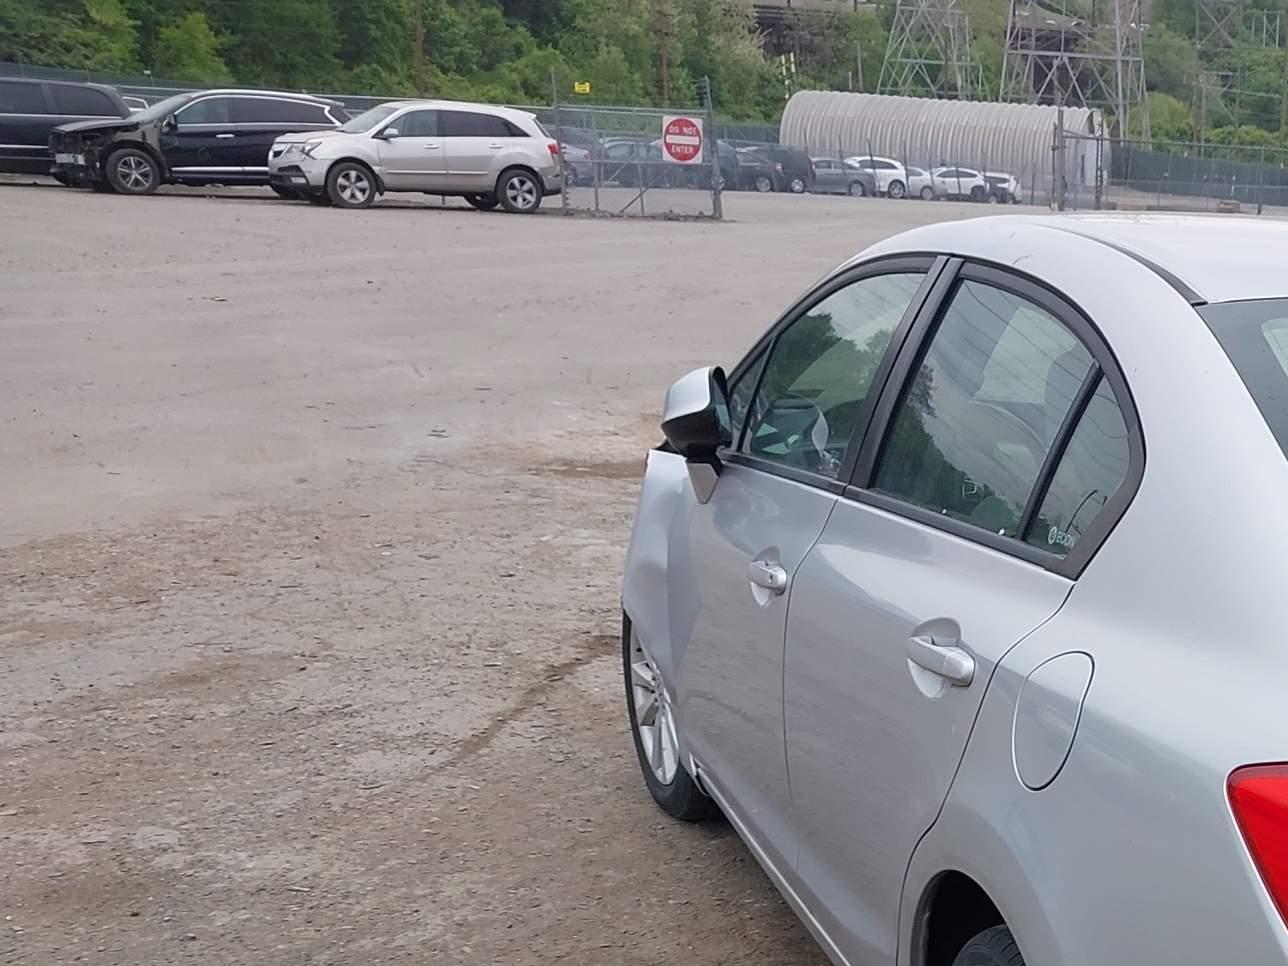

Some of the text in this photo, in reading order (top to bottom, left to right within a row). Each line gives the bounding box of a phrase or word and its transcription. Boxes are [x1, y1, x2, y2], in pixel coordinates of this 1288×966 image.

[669, 125, 697, 135] DO NOT
[671, 145, 694, 153] ENTER
